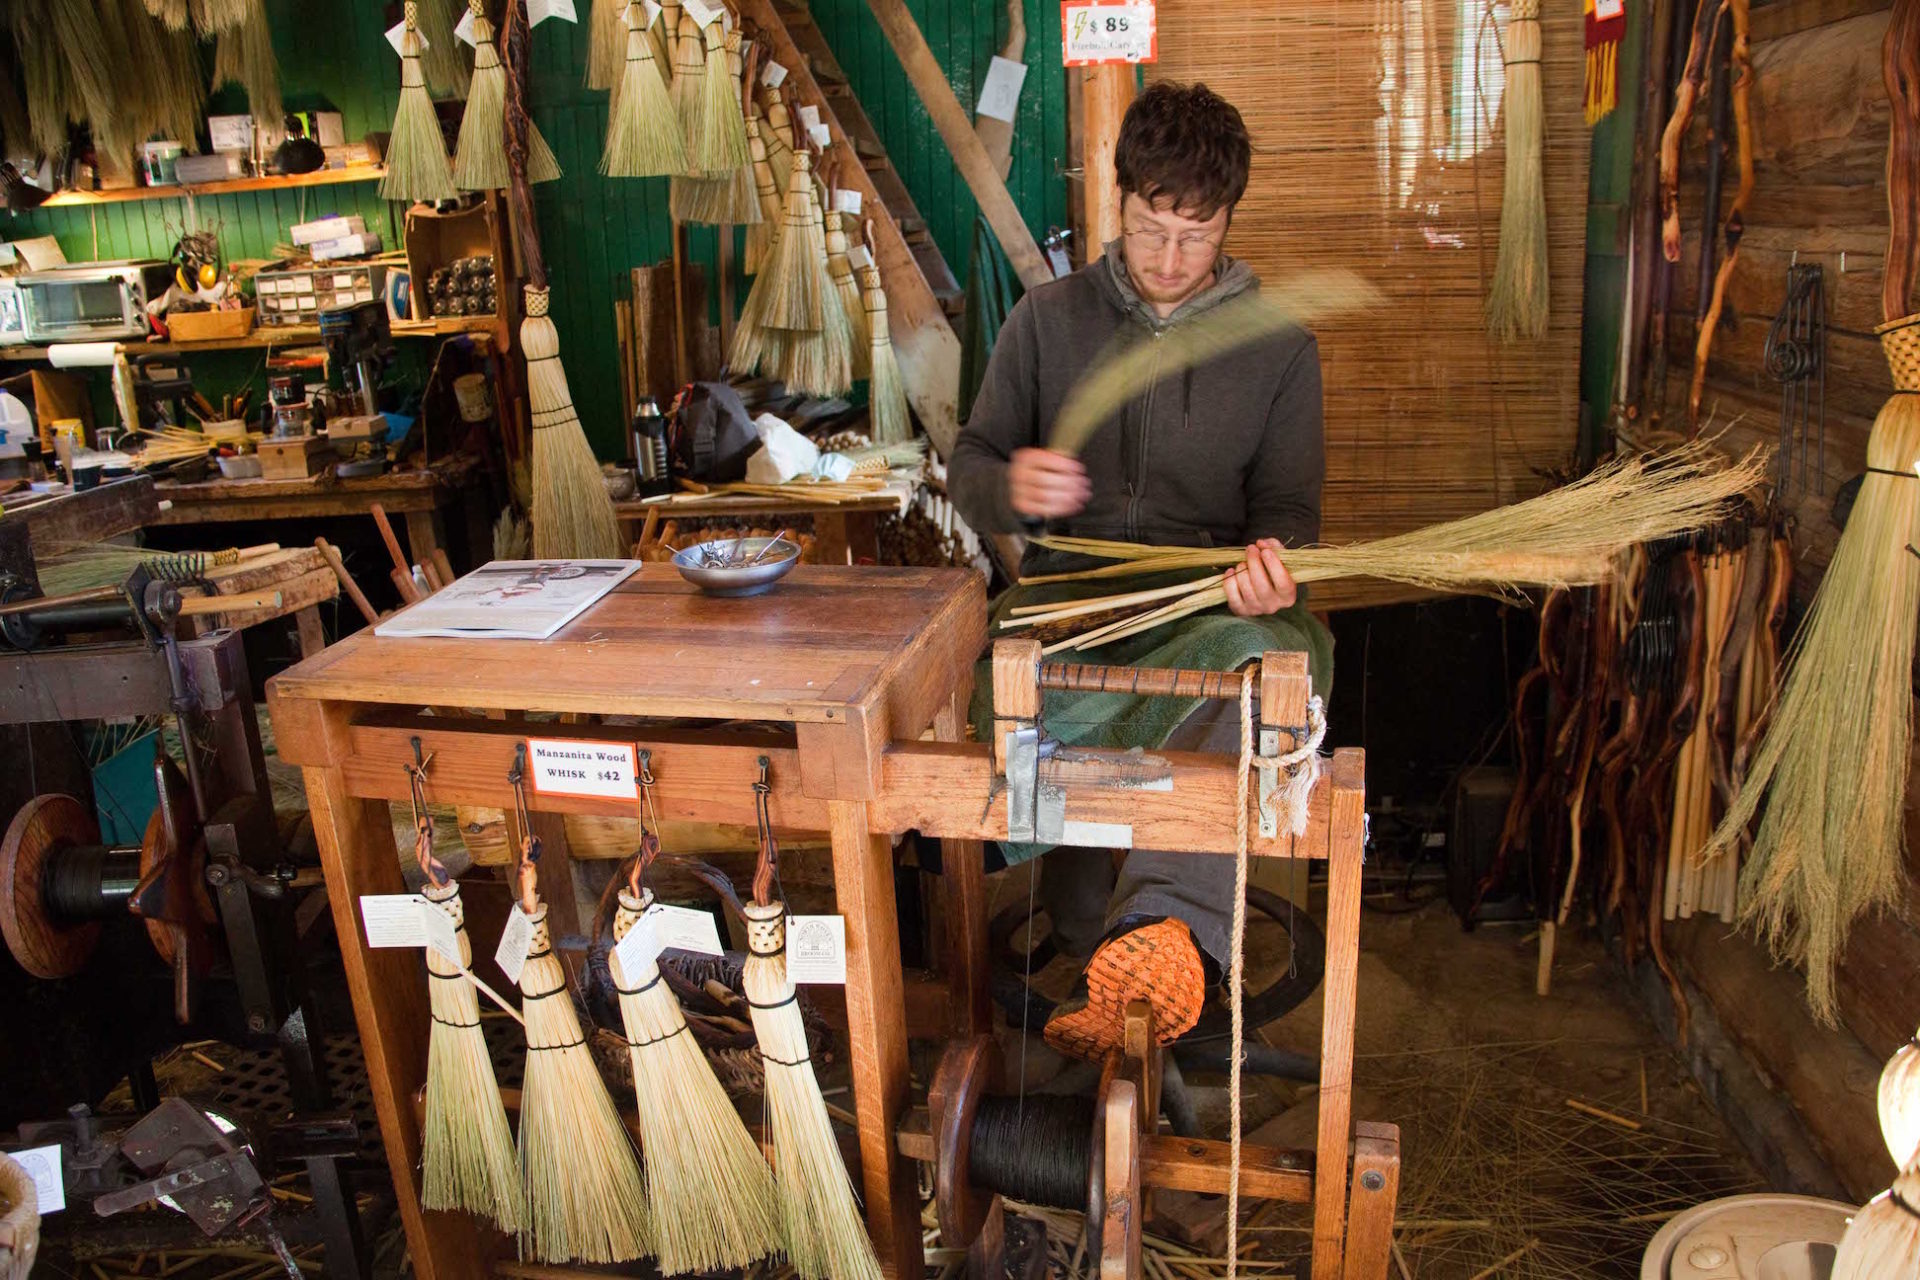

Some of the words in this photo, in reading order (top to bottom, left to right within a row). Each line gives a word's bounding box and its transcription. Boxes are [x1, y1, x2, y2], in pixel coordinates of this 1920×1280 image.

[1090, 20, 1098, 35] $
[1106, 17, 1129, 32] 89
[537, 749, 592, 760] Manzanita
[596, 752, 626, 762] Wood
[547, 768, 586, 779] WHISK
[597, 770, 620, 781] $42
